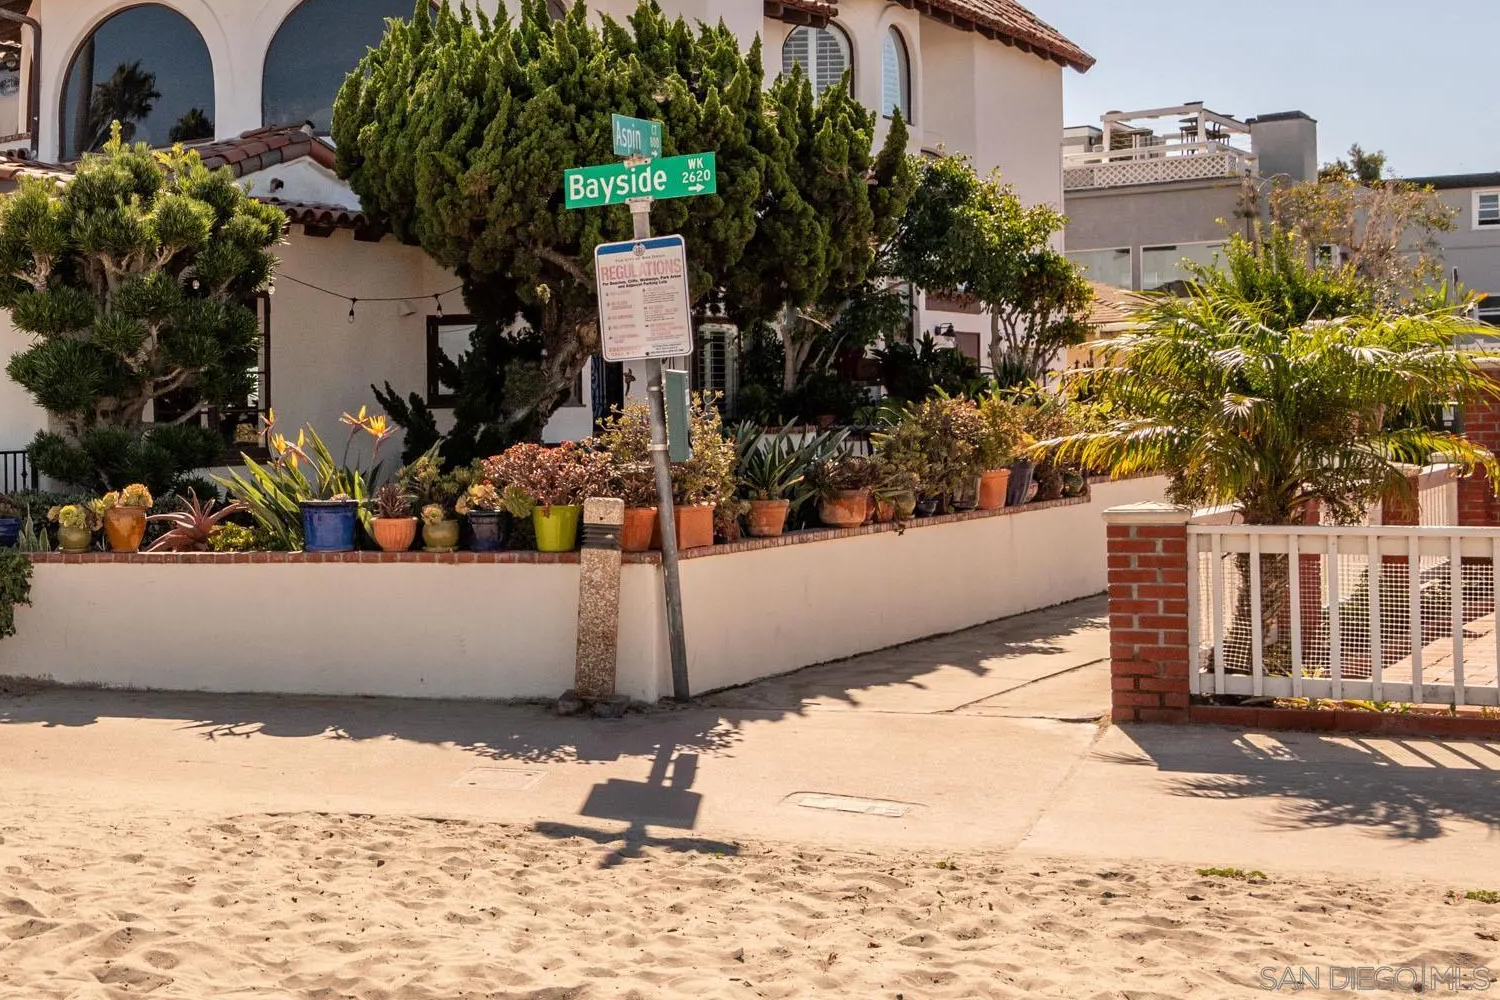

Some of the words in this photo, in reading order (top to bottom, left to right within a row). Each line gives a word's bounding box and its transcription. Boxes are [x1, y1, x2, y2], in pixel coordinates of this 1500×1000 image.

[616, 120, 642, 156] Aspin
[651, 124, 657, 136] CT
[687, 157, 704, 170] WK
[568, 166, 667, 204] Bayside
[682, 169, 711, 184] 2620
[600, 259, 682, 281] REGULATIONS
